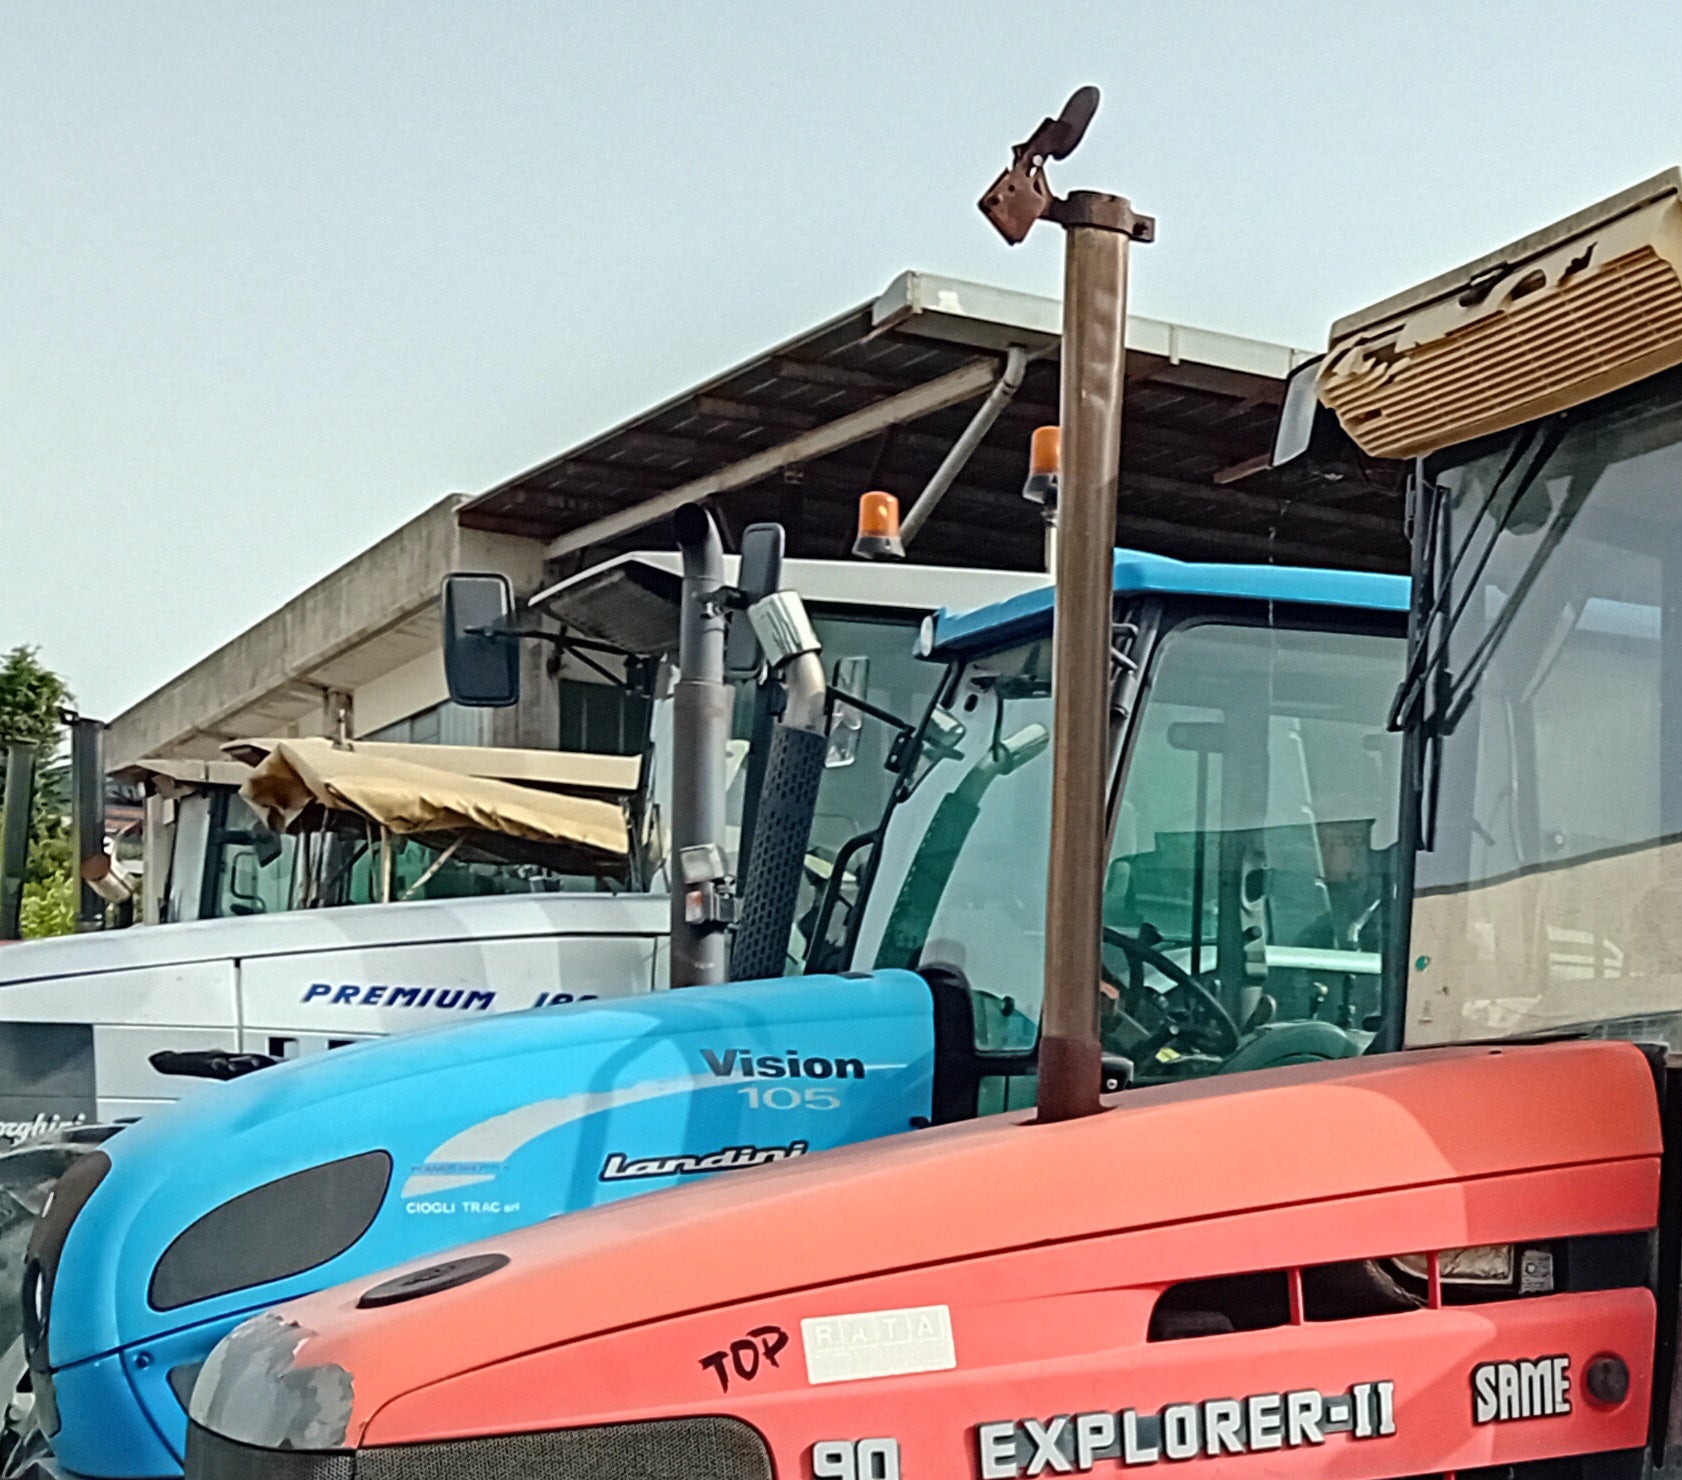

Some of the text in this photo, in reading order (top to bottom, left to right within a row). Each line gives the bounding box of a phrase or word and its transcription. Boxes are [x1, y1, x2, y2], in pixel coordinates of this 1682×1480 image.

[301, 983, 497, 1012] PREMIUM
[700, 1048, 865, 1079] Vision
[737, 1086, 841, 1110] 105
[602, 1142, 807, 1180] Landini
[405, 1202, 456, 1214] CIOGLI
[462, 1201, 501, 1214] TRAC
[698, 1326, 790, 1394] TOP
[1473, 1356, 1571, 1424] SAME
